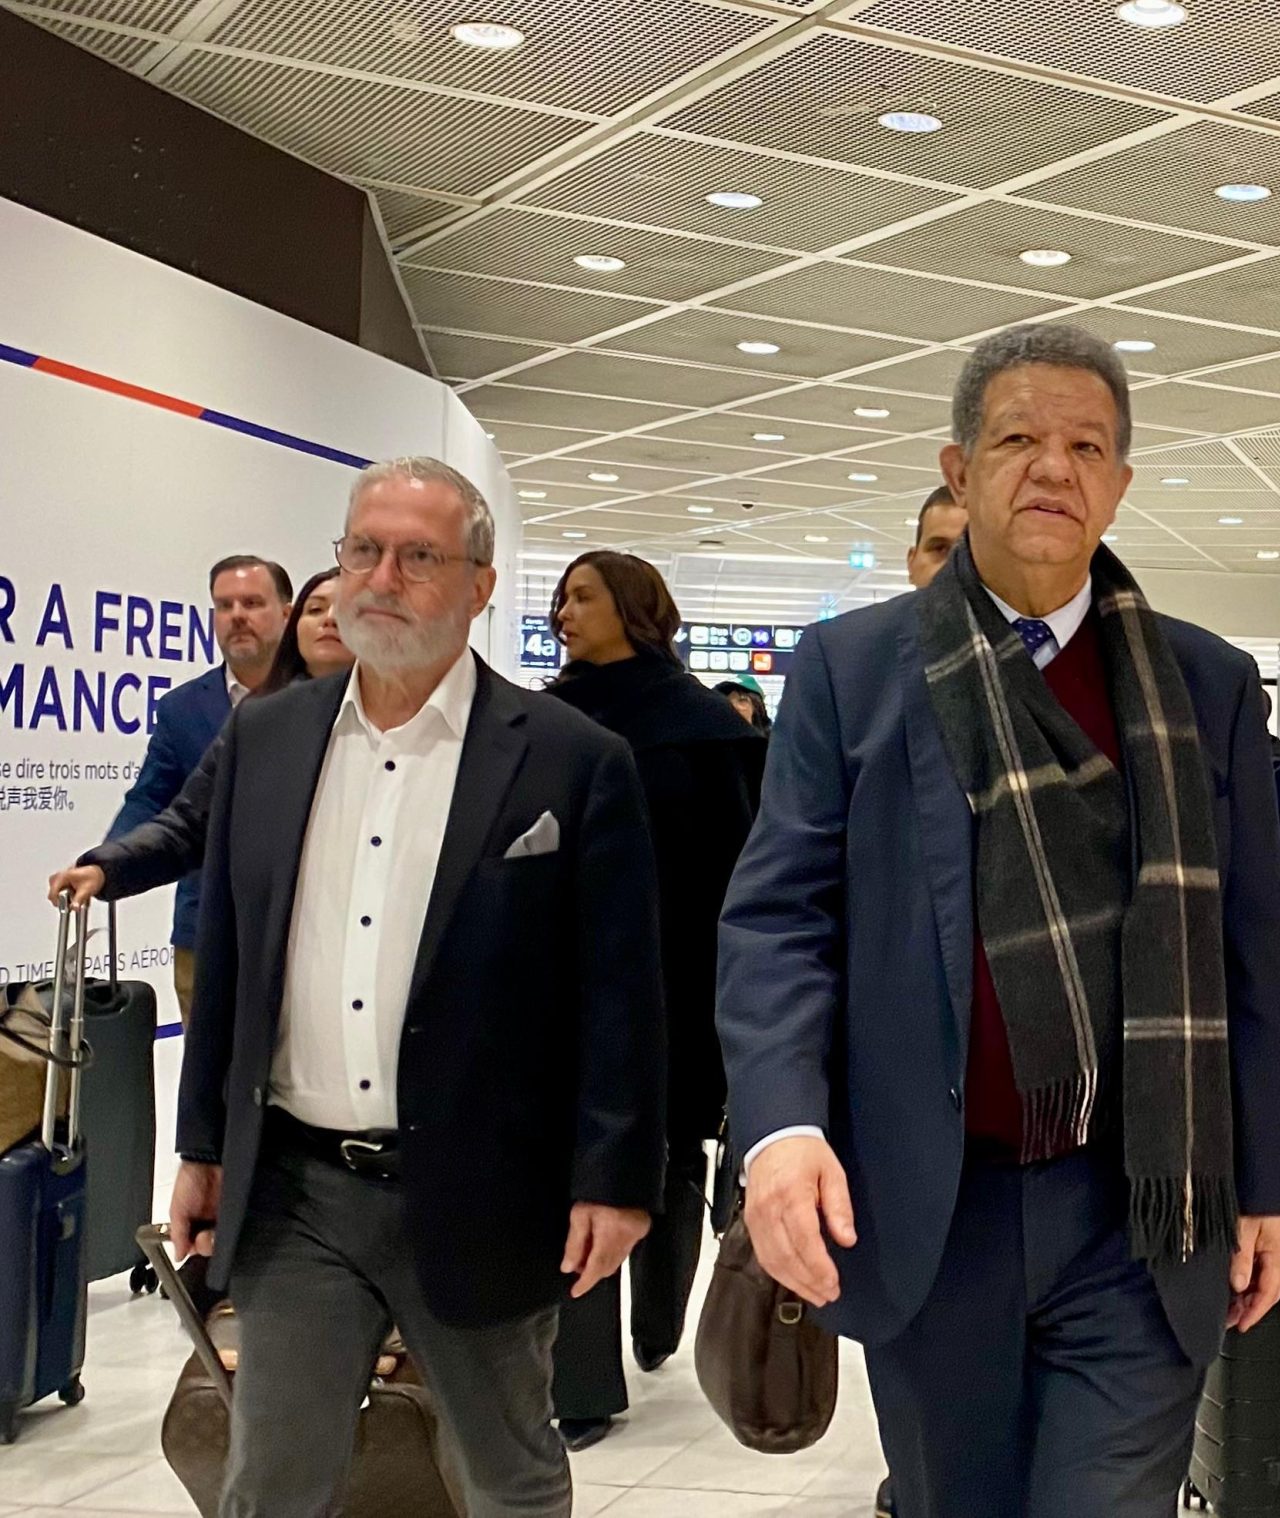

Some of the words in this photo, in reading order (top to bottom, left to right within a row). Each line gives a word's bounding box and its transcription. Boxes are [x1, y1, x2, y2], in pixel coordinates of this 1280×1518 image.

[36, 583, 74, 650] A
[94, 590, 214, 664] FREN
[16, 758, 45, 779] dire
[49, 759, 80, 780] trois
[85, 761, 119, 780] mots
[84, 952, 126, 974] PARS
